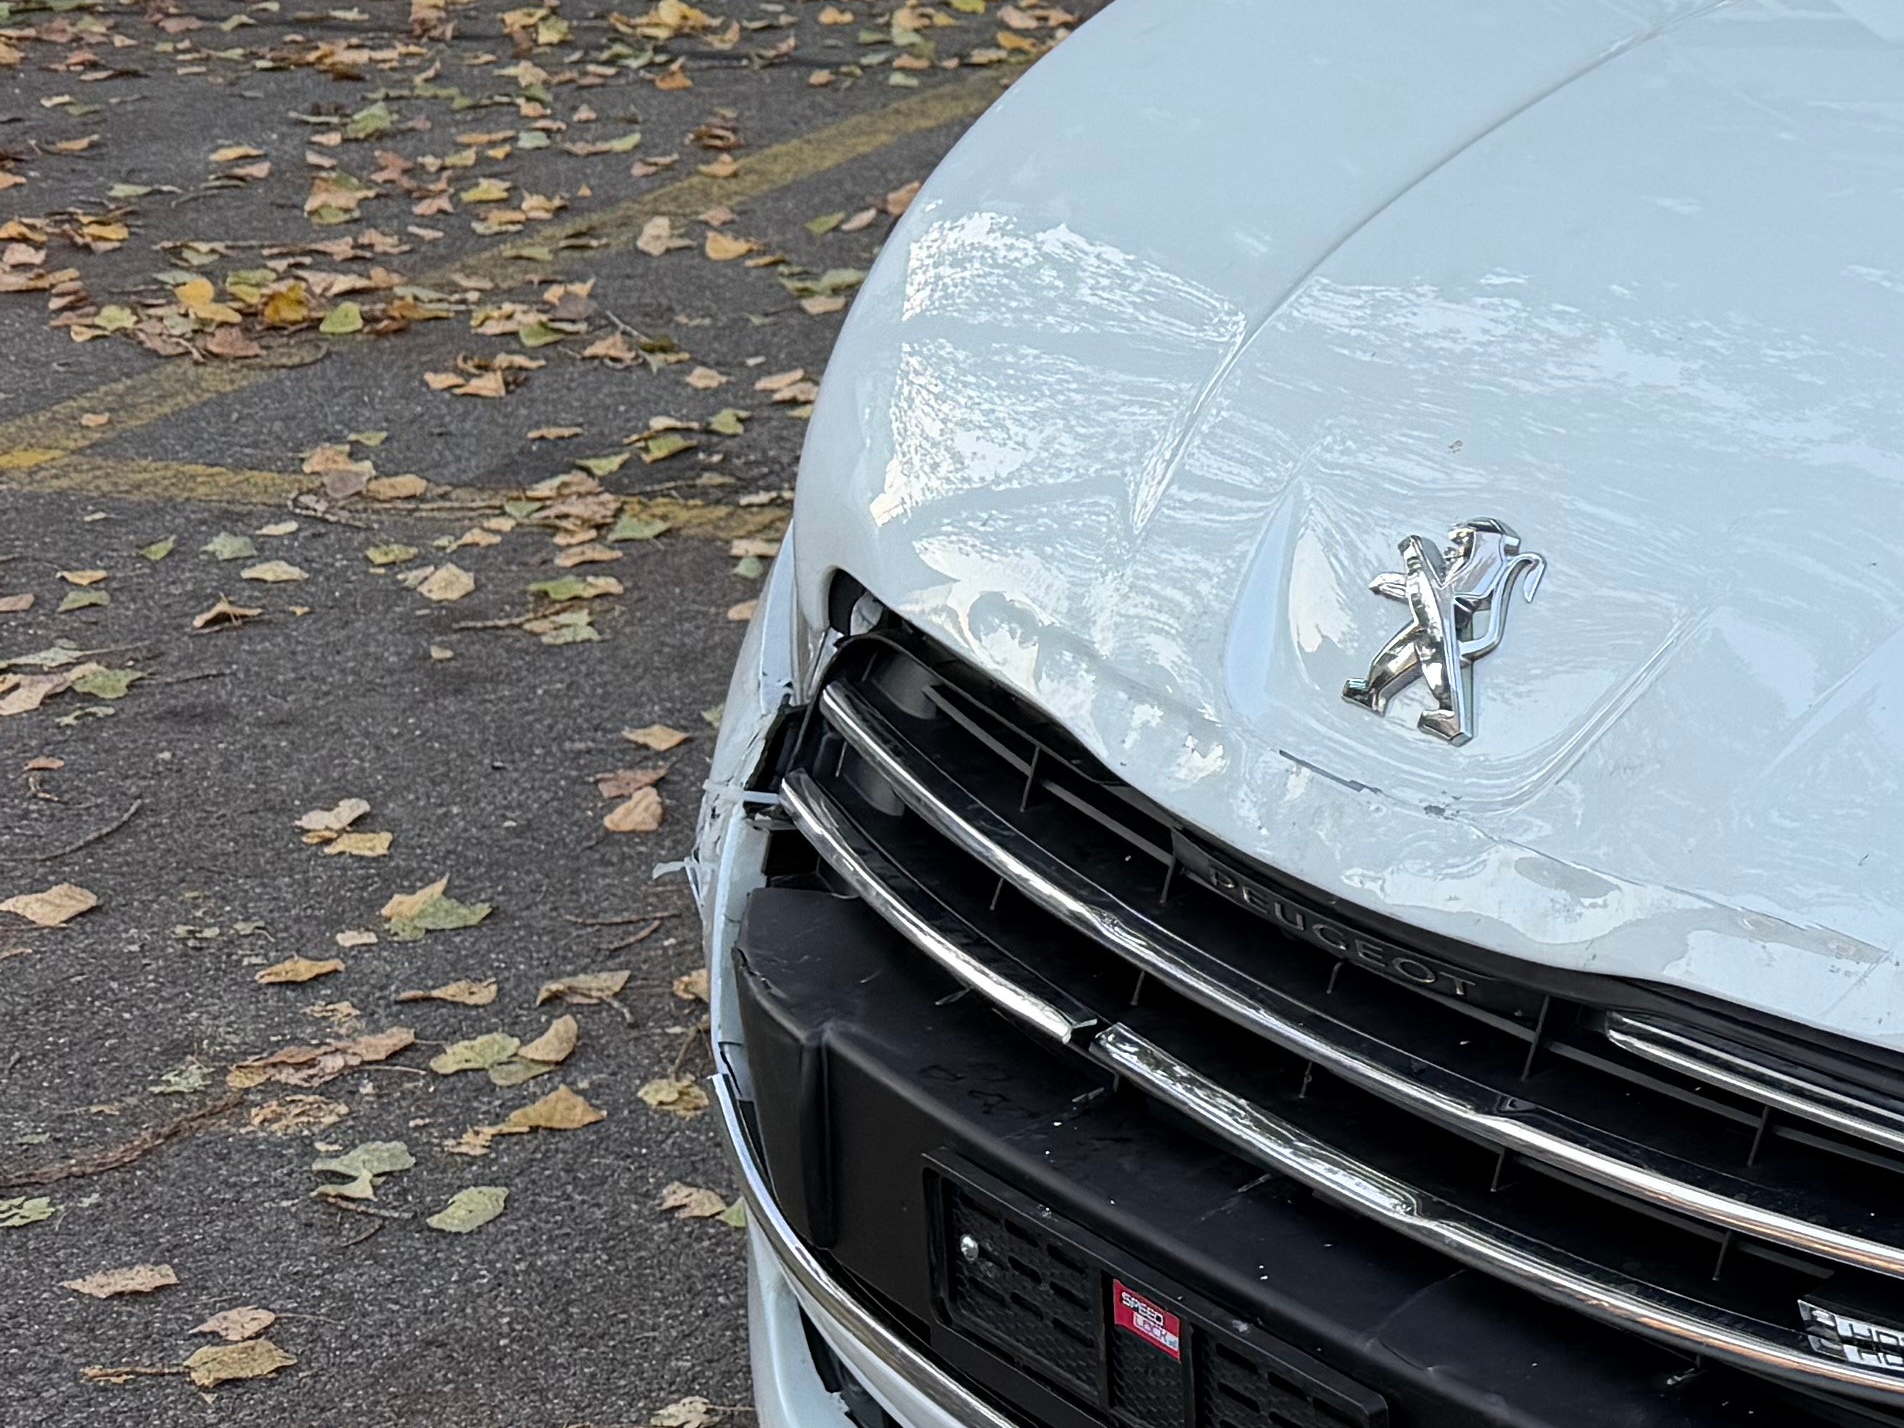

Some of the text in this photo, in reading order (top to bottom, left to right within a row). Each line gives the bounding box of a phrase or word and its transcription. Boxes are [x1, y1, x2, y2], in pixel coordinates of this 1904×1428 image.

[1209, 870, 1476, 996] PEUGEOT
[1121, 1291, 1164, 1325] SPEED
[1135, 1313, 1168, 1343] LOCK
